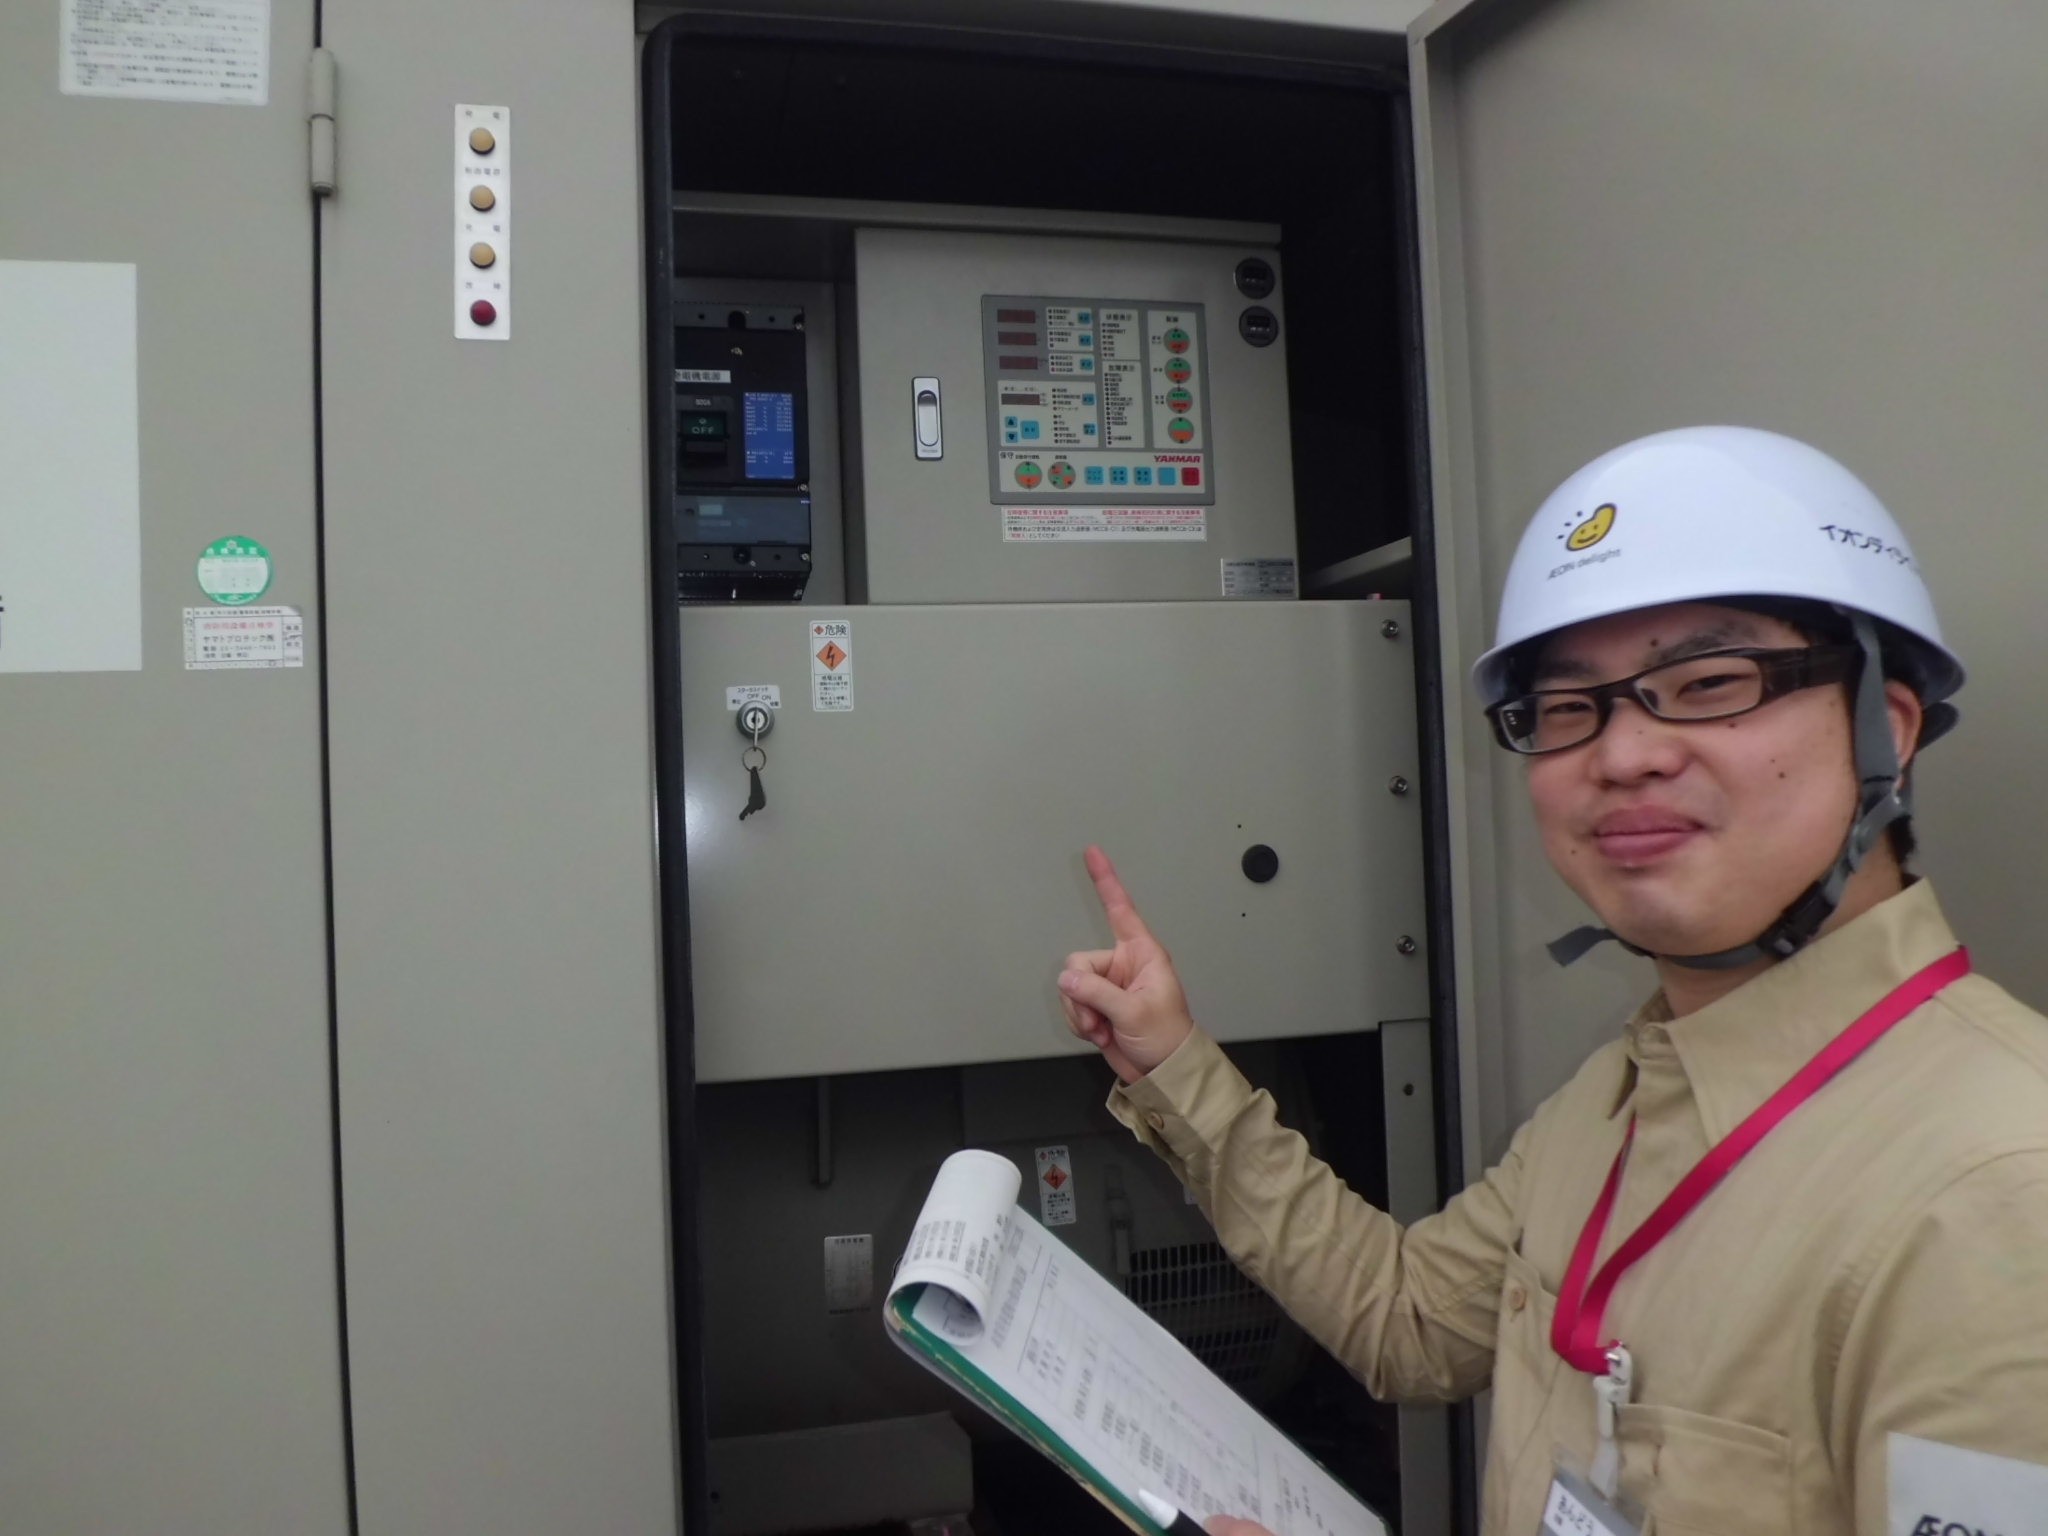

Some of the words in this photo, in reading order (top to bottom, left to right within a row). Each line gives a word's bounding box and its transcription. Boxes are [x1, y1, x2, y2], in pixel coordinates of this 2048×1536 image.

[691, 426, 714, 434] OFF
[1154, 455, 1201, 463] YANMAR
[1577, 549, 1621, 567] delight
[825, 624, 847, 636] 危険
